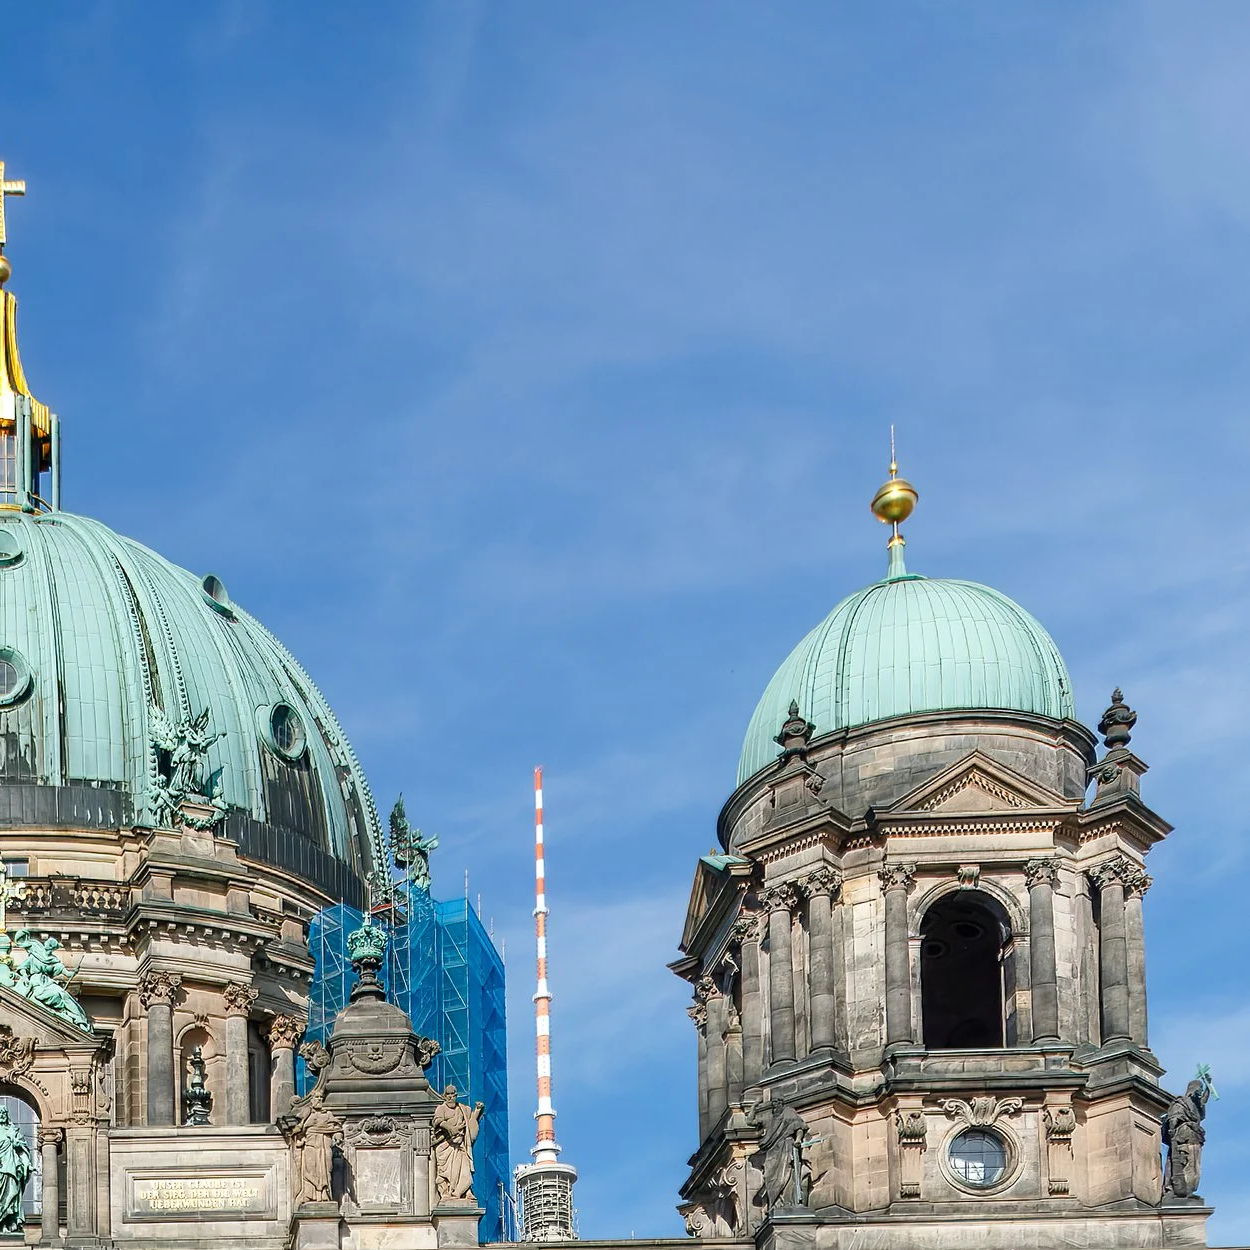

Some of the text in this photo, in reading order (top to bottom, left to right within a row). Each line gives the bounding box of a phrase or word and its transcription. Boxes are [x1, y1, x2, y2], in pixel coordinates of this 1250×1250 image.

[151, 1180, 246, 1190] UNSER GLAUBE IST
[141, 1190, 160, 1200] DER
[190, 1190, 210, 1198] DER
[214, 1189, 230, 1198] DIE
[232, 1188, 258, 1198] WELT
[150, 1199, 226, 1209] UEBERWUNDEN
